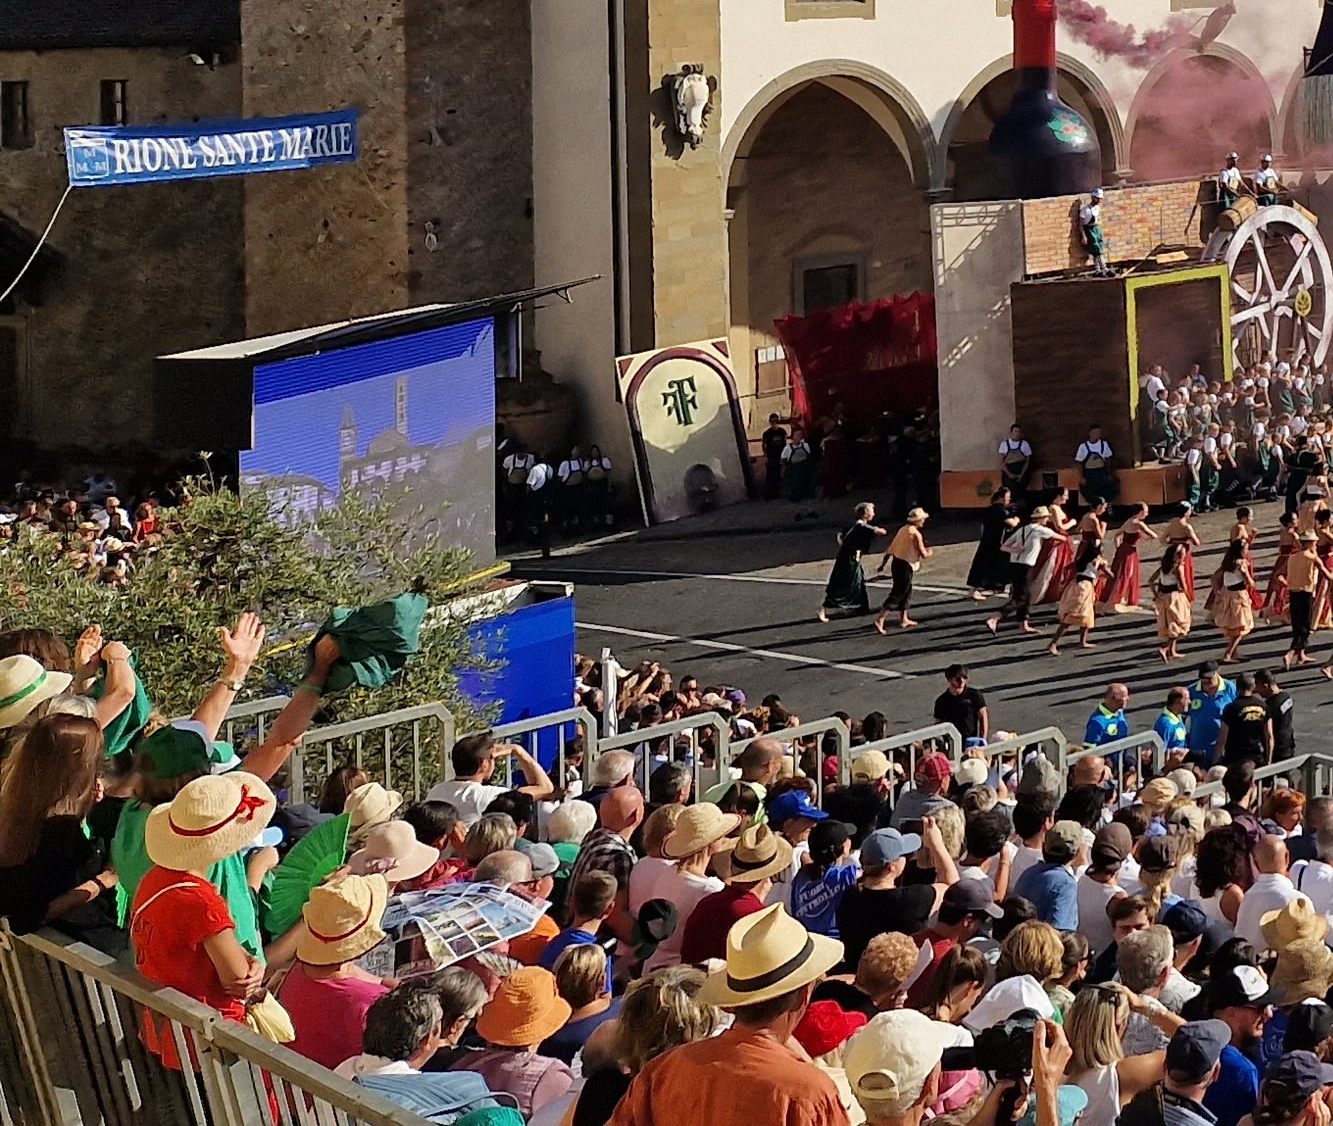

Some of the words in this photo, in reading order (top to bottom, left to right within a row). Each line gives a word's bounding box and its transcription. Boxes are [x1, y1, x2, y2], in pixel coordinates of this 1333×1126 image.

[111, 135, 197, 174] RIONE
[200, 130, 278, 168] SANTE
[279, 122, 353, 160] MARIE
